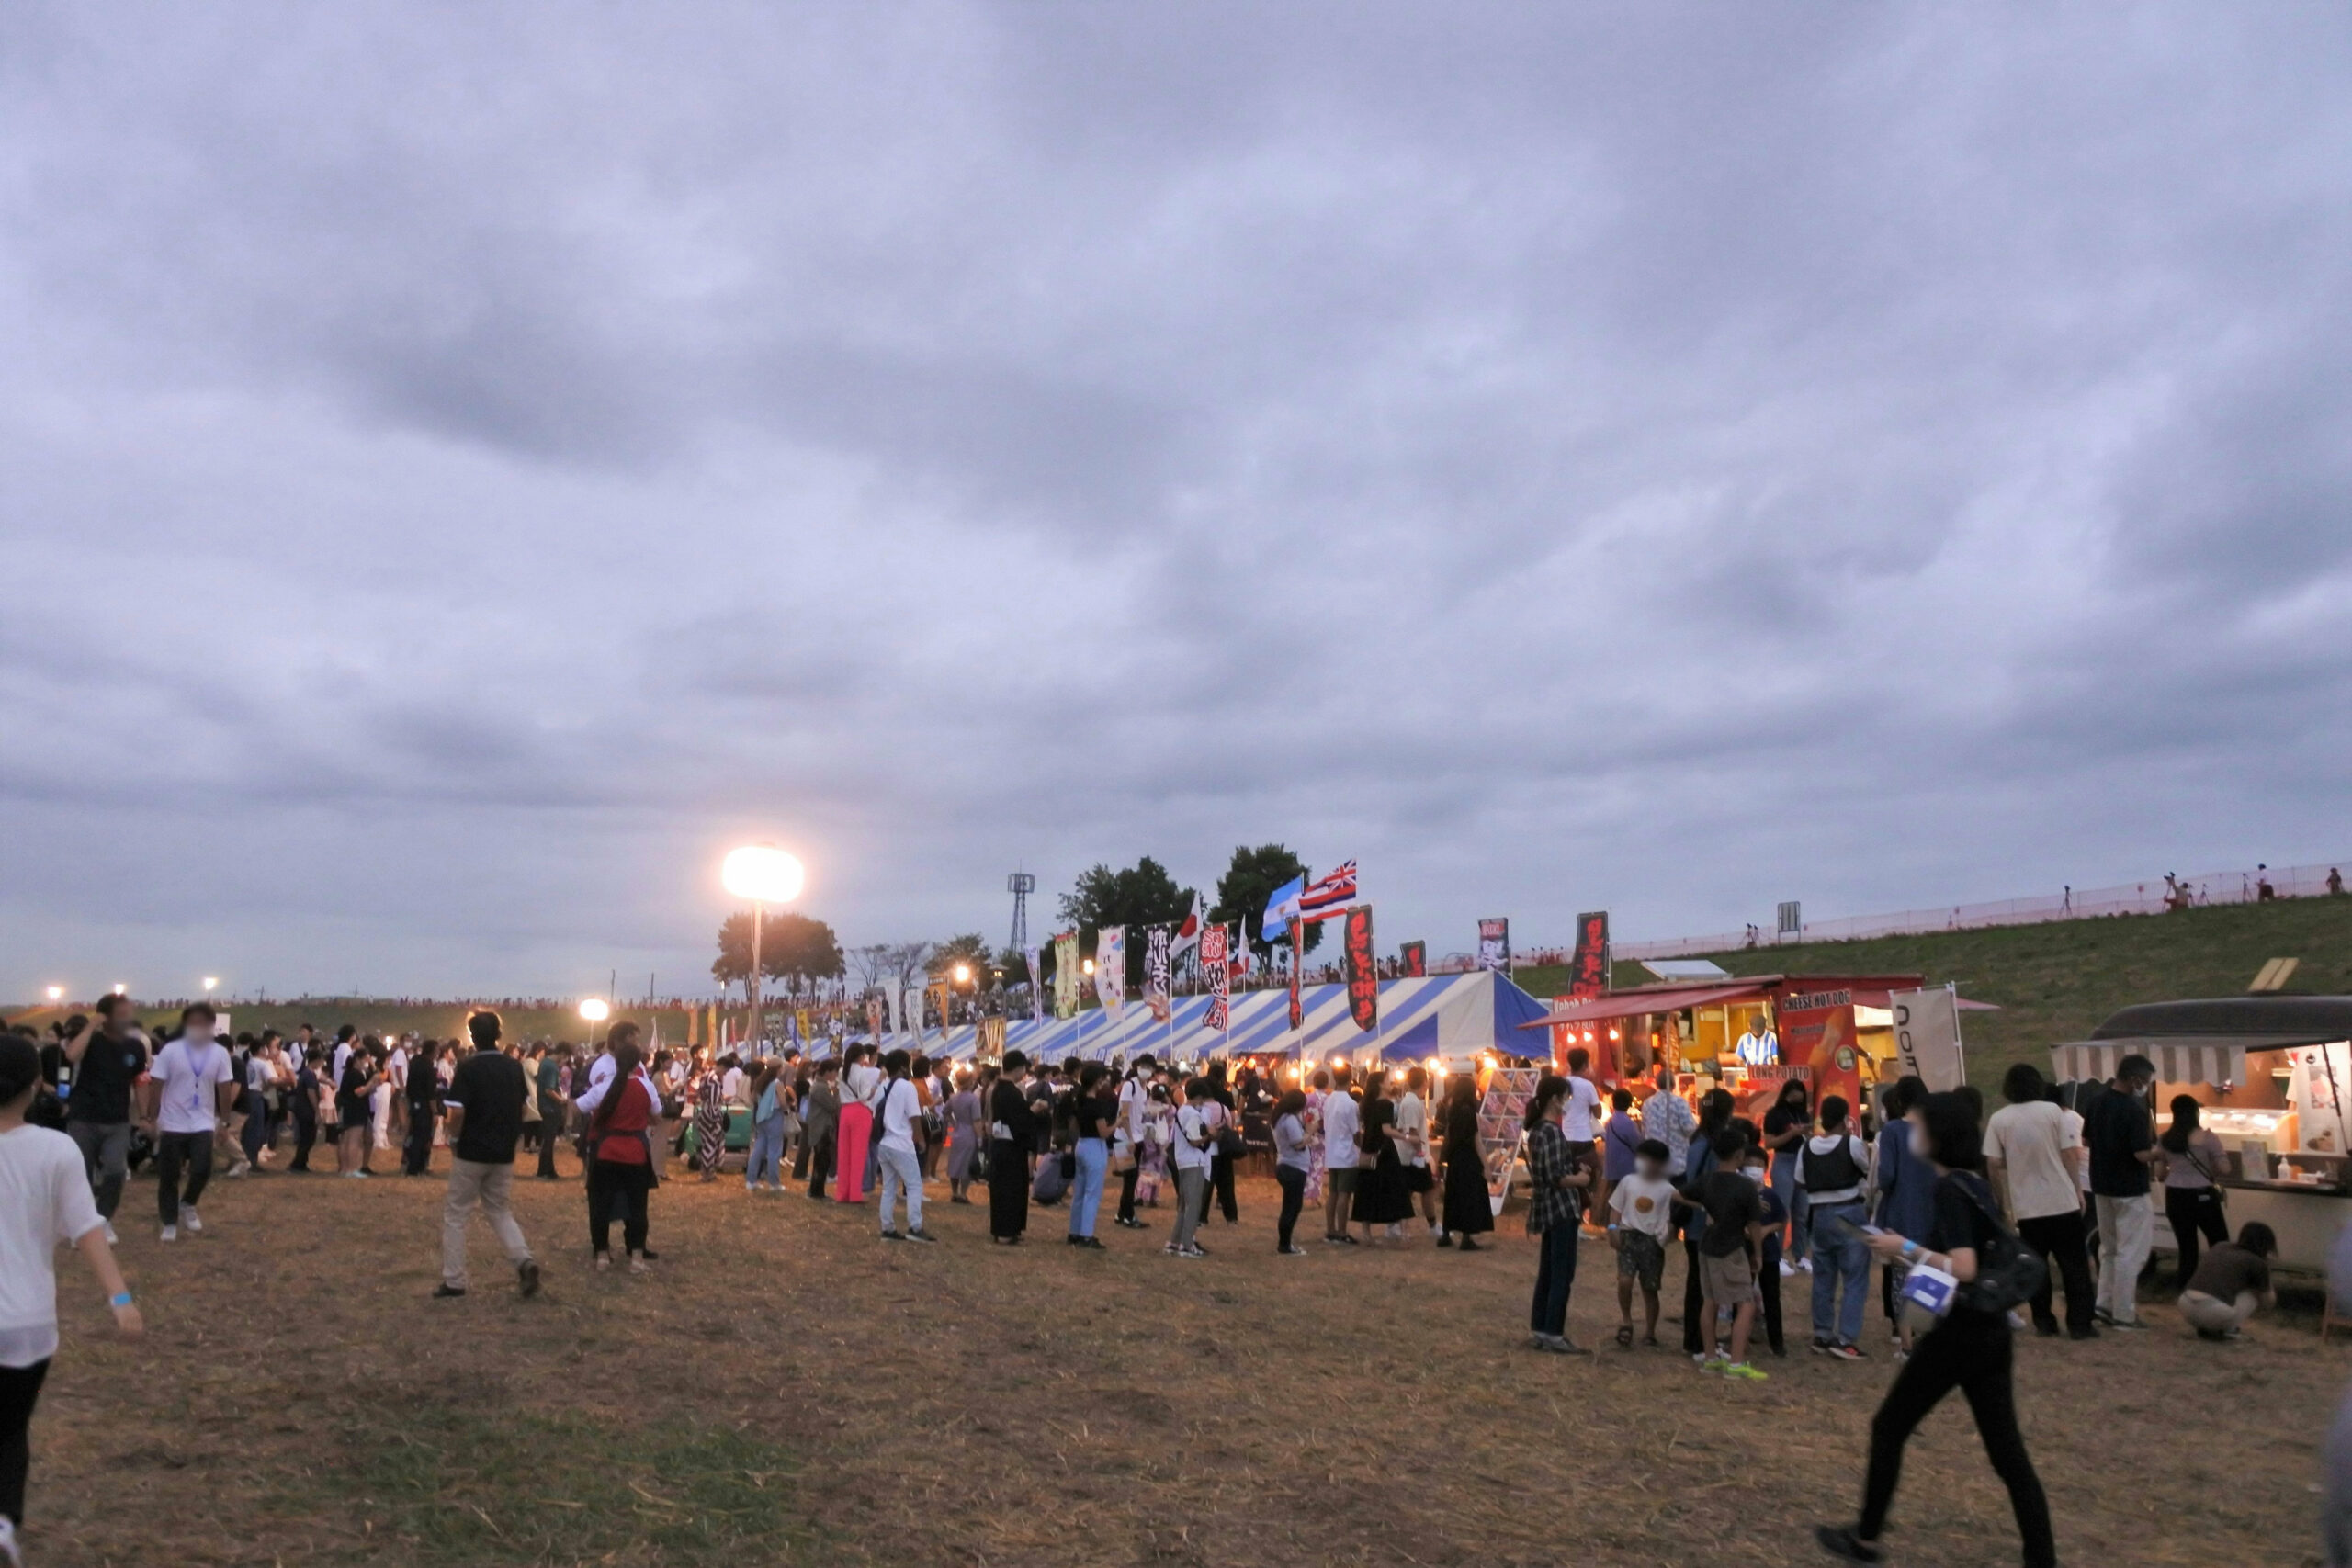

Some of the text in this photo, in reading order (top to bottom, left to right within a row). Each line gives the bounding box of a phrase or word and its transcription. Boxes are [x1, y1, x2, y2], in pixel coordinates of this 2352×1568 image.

[1783, 990, 1851, 1011] CHEESE HOT DOG
[1751, 1066, 1809, 1079] LONG POTATO
